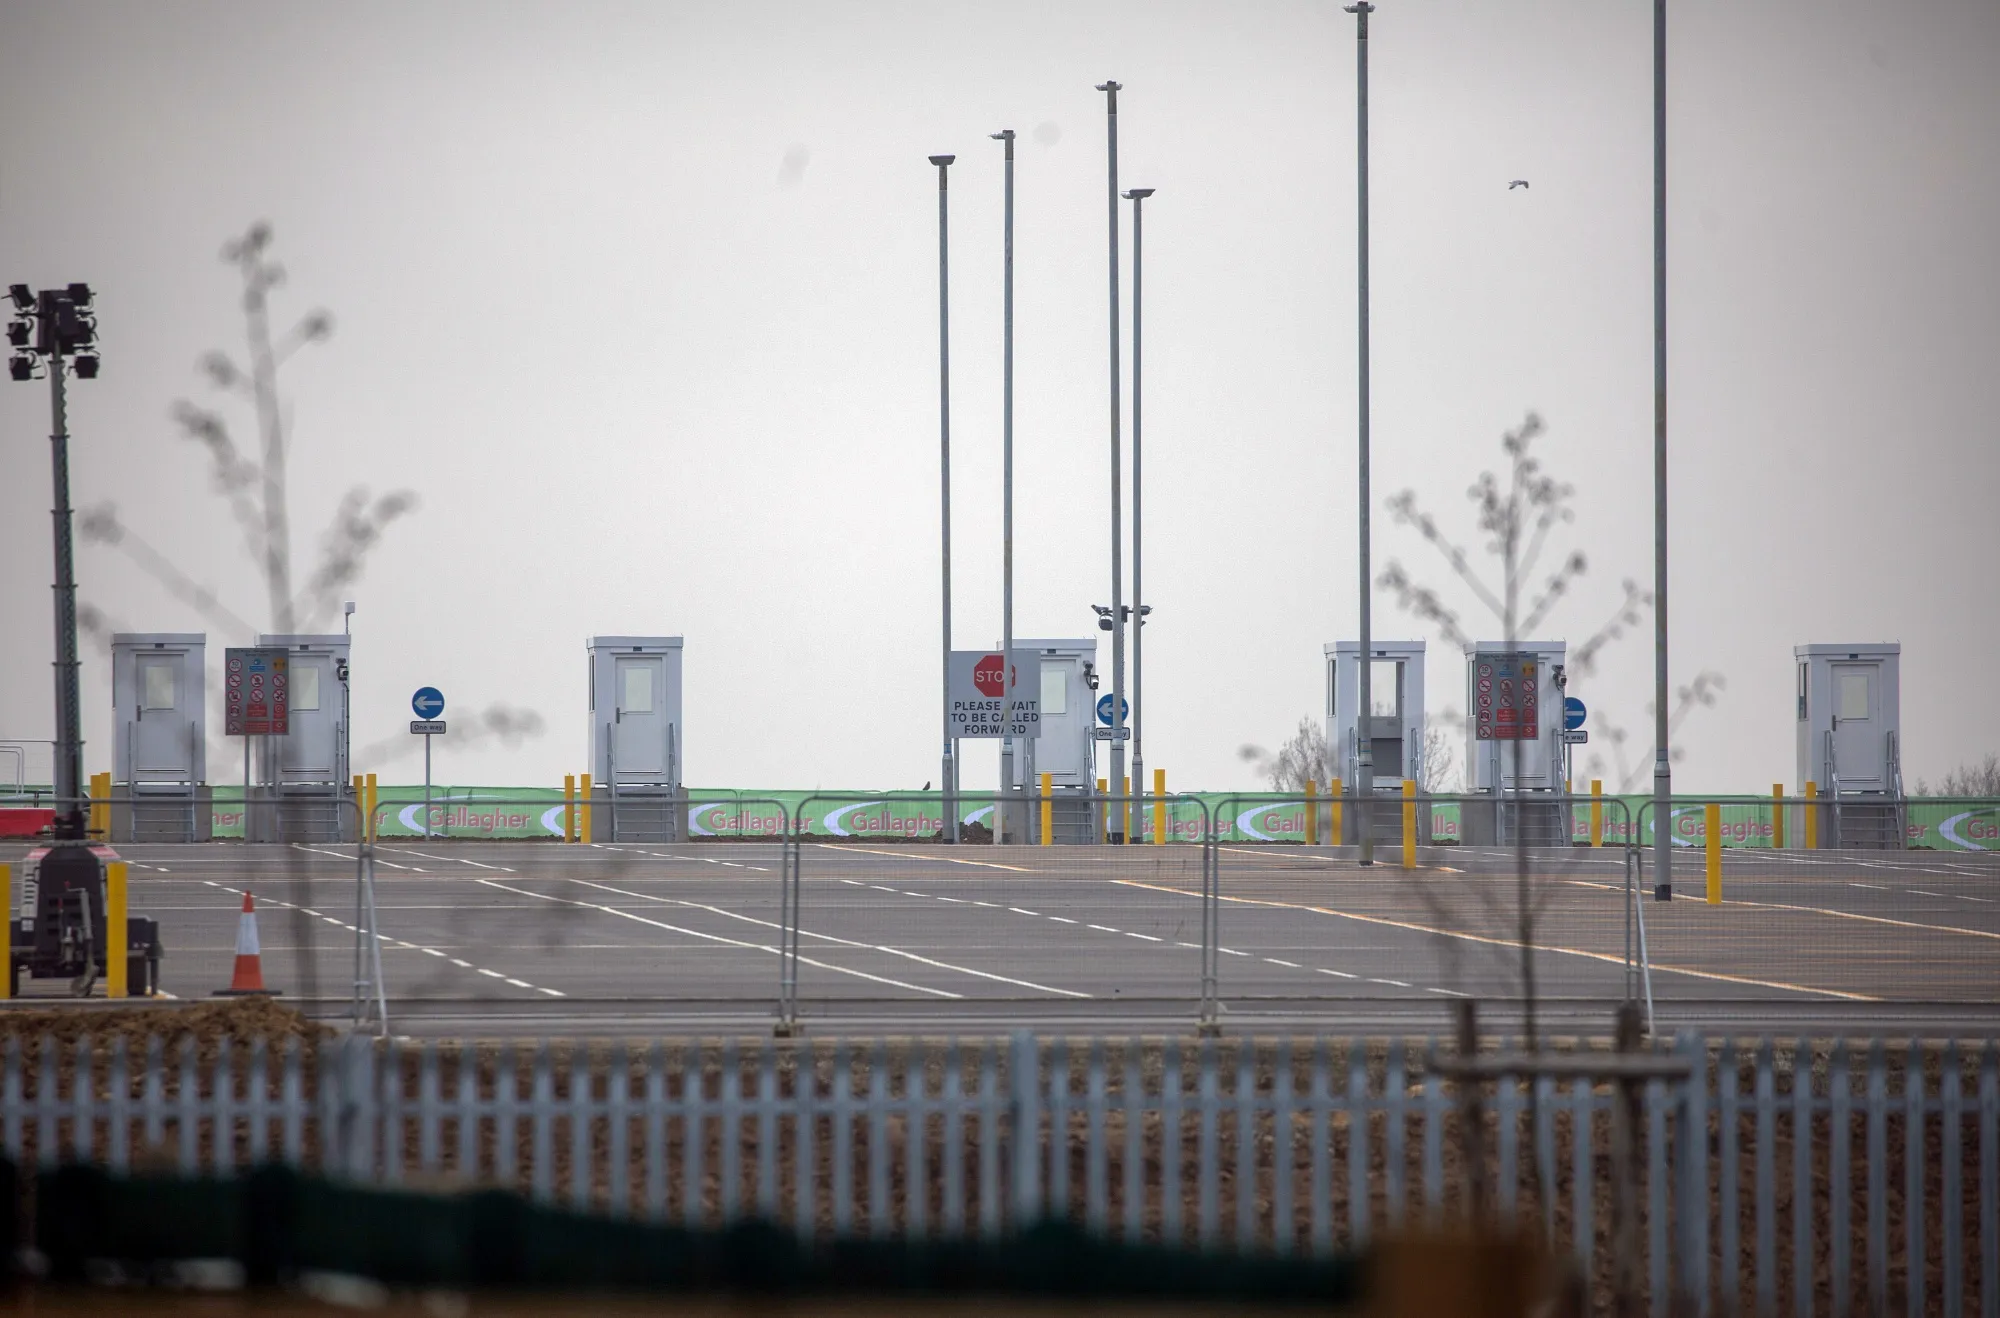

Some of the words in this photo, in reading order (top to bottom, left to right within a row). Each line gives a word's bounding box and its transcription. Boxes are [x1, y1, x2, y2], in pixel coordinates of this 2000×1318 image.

[976, 670, 1014, 682] STO
[954, 701, 1001, 710] PLEASE
[951, 713, 967, 722] TO
[972, 713, 987, 722] BE
[429, 807, 532, 832] Gallagher
[709, 810, 813, 835] Gallagher
